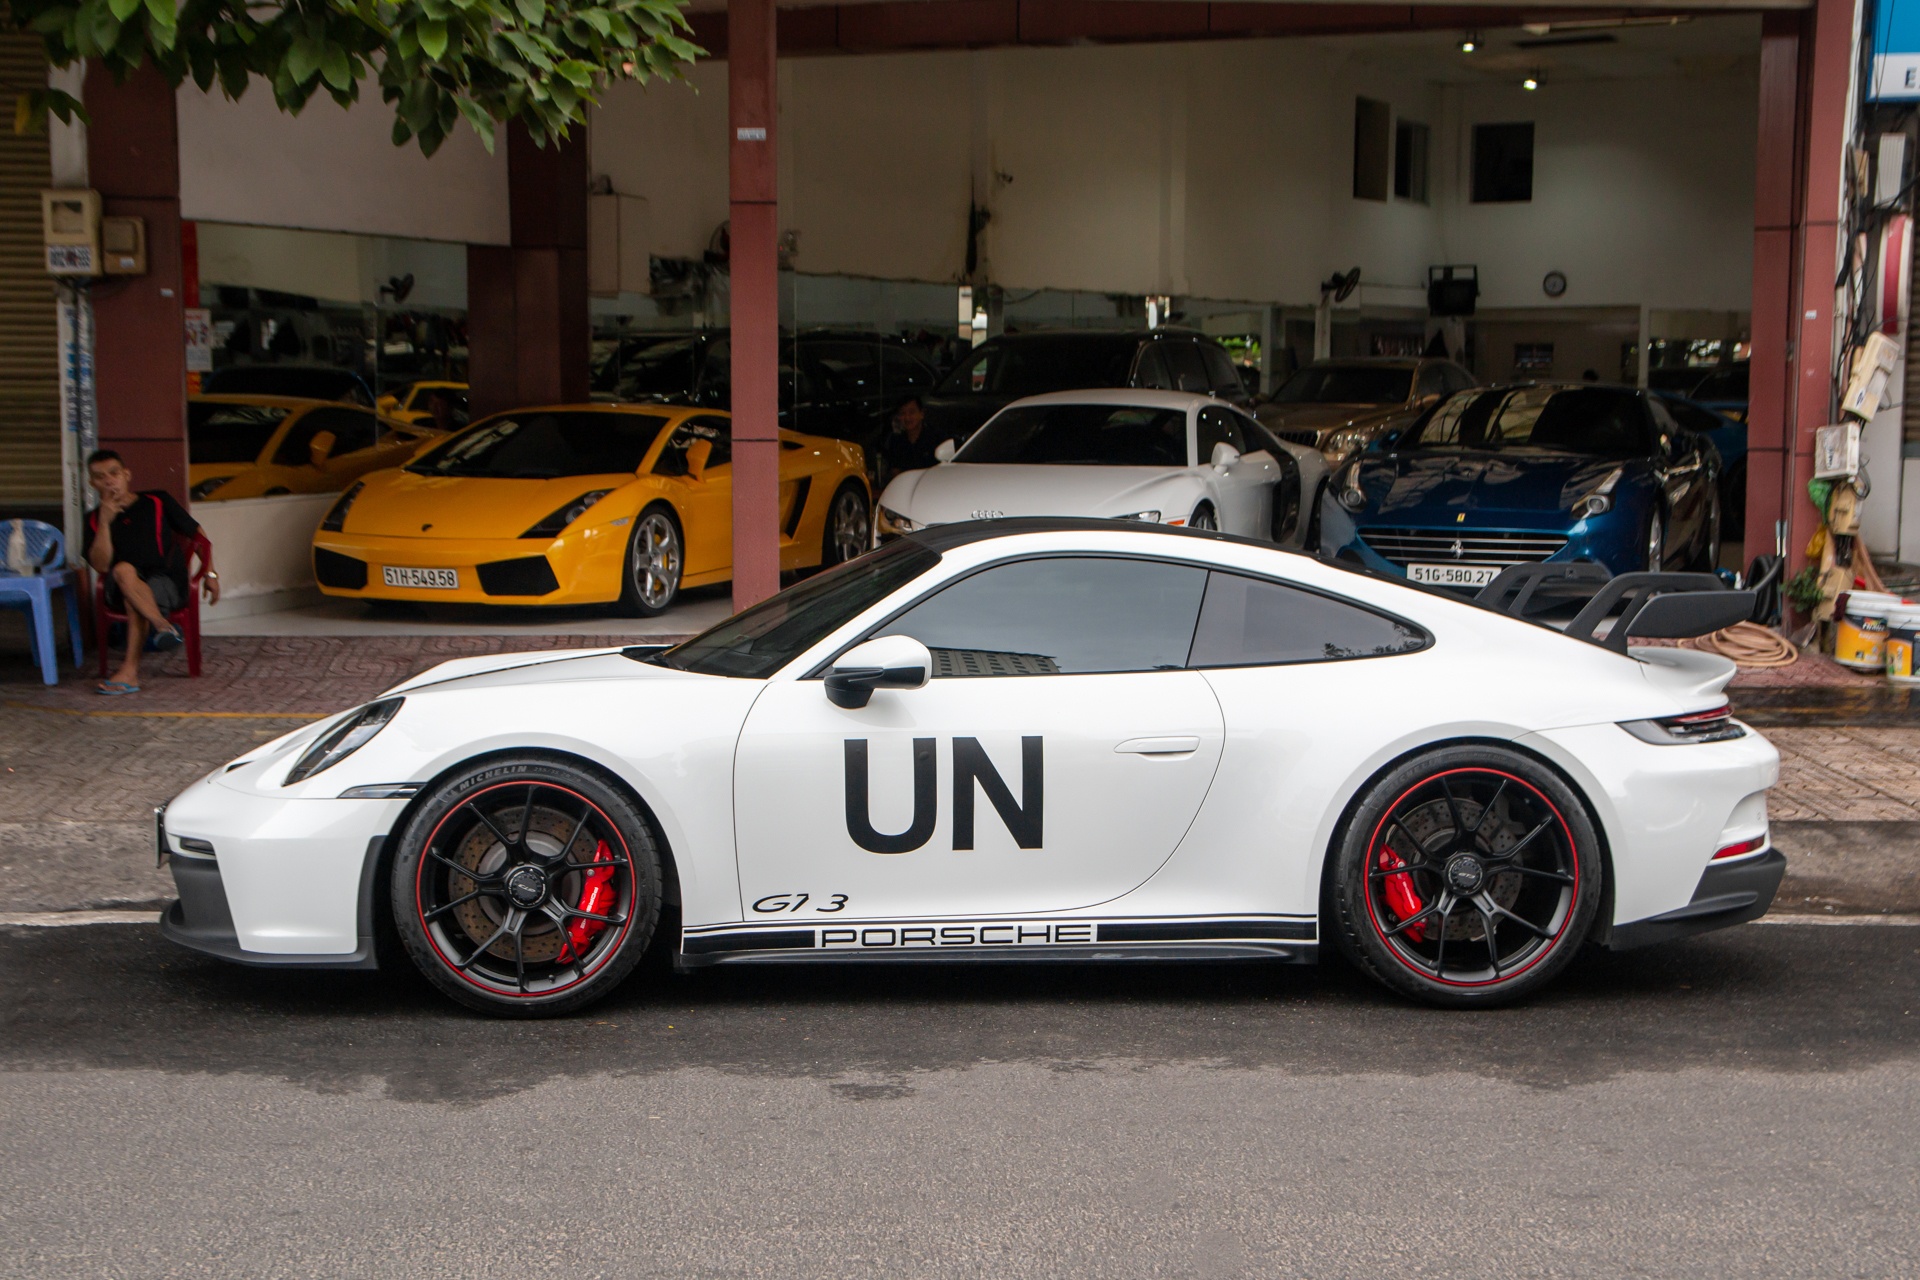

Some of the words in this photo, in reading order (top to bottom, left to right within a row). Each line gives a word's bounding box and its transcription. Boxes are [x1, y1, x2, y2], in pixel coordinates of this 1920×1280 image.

[459, 765, 528, 792] MICHELIN
[844, 736, 1043, 854] UN
[821, 924, 1092, 948] PORSCHE
